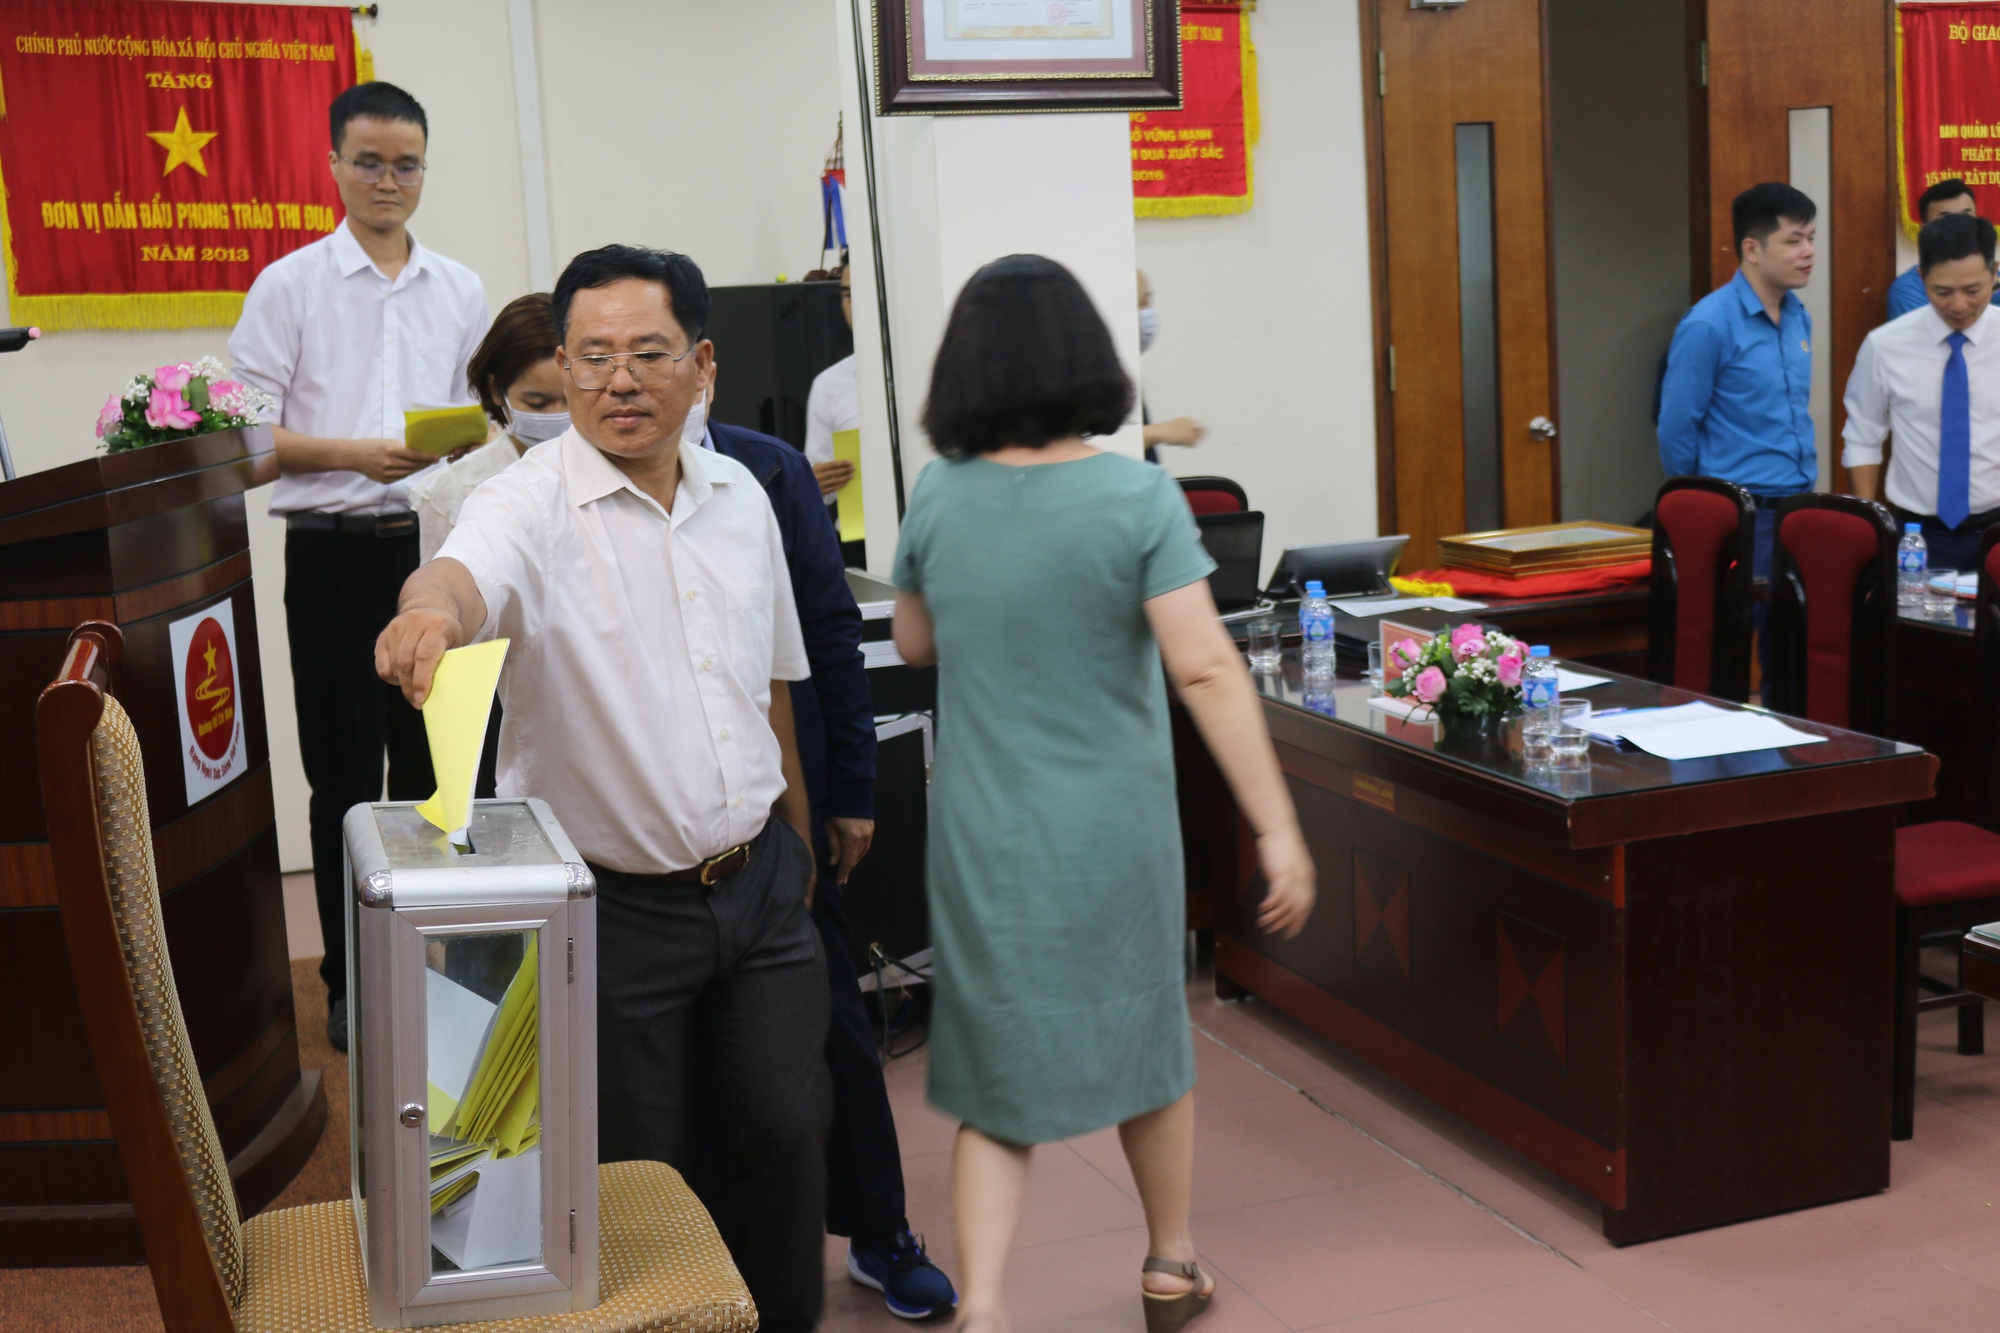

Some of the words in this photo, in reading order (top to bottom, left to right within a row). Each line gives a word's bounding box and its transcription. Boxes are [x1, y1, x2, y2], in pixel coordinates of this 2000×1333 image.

[1181, 21, 1199, 44] IỆT
[1200, 26, 1223, 42] NAM
[1948, 19, 1970, 45] BỘ
[16, 31, 55, 54] CHÍNH
[57, 31, 82, 55] PHỦ
[84, 33, 117, 56] NƯỚC
[117, 34, 150, 61] CỘNG
[195, 36, 217, 63] HỘI
[218, 36, 243, 59] CHỦ
[281, 38, 308, 64] VIỆT
[310, 44, 336, 61] NAM
[145, 71, 214, 92] TẶNG
[1960, 119, 1988, 140] QUẢN
[1961, 144, 1993, 162] PHÁT
[1924, 171, 1939, 187] 15
[41, 200, 79, 229] ĐƠN
[81, 202, 101, 234] VỊ
[176, 202, 230, 230] PHONG
[231, 197, 275, 230] TRÀO
[276, 203, 301, 230] THI
[303, 204, 336, 233] ĐUA
[141, 243, 196, 262] NĂM
[200, 247, 250, 262] 2013
